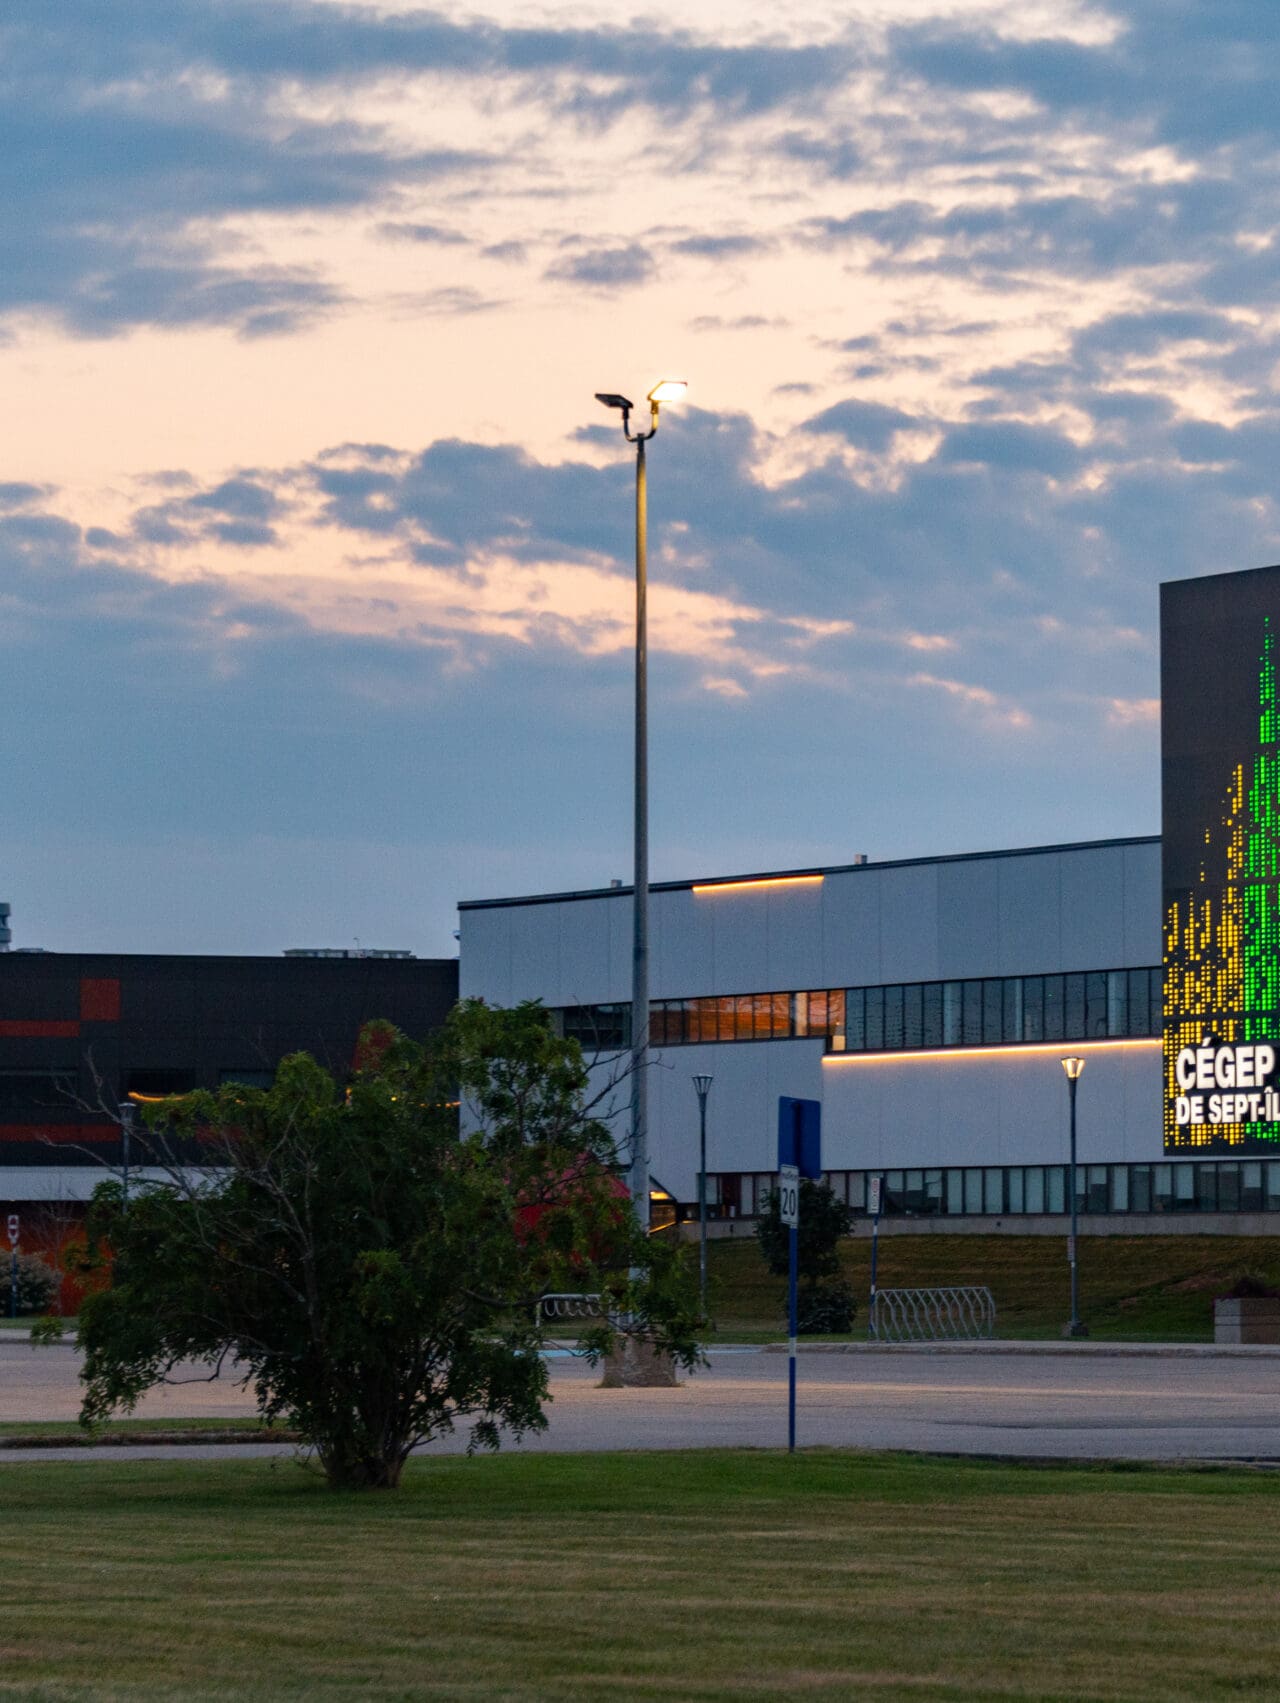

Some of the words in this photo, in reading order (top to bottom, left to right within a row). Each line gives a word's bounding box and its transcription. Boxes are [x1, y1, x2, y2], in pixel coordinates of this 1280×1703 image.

[1176, 1037, 1275, 1089] CÉGEP
[1175, 1096, 1204, 1125] DE
[782, 1188, 796, 1216] 20
